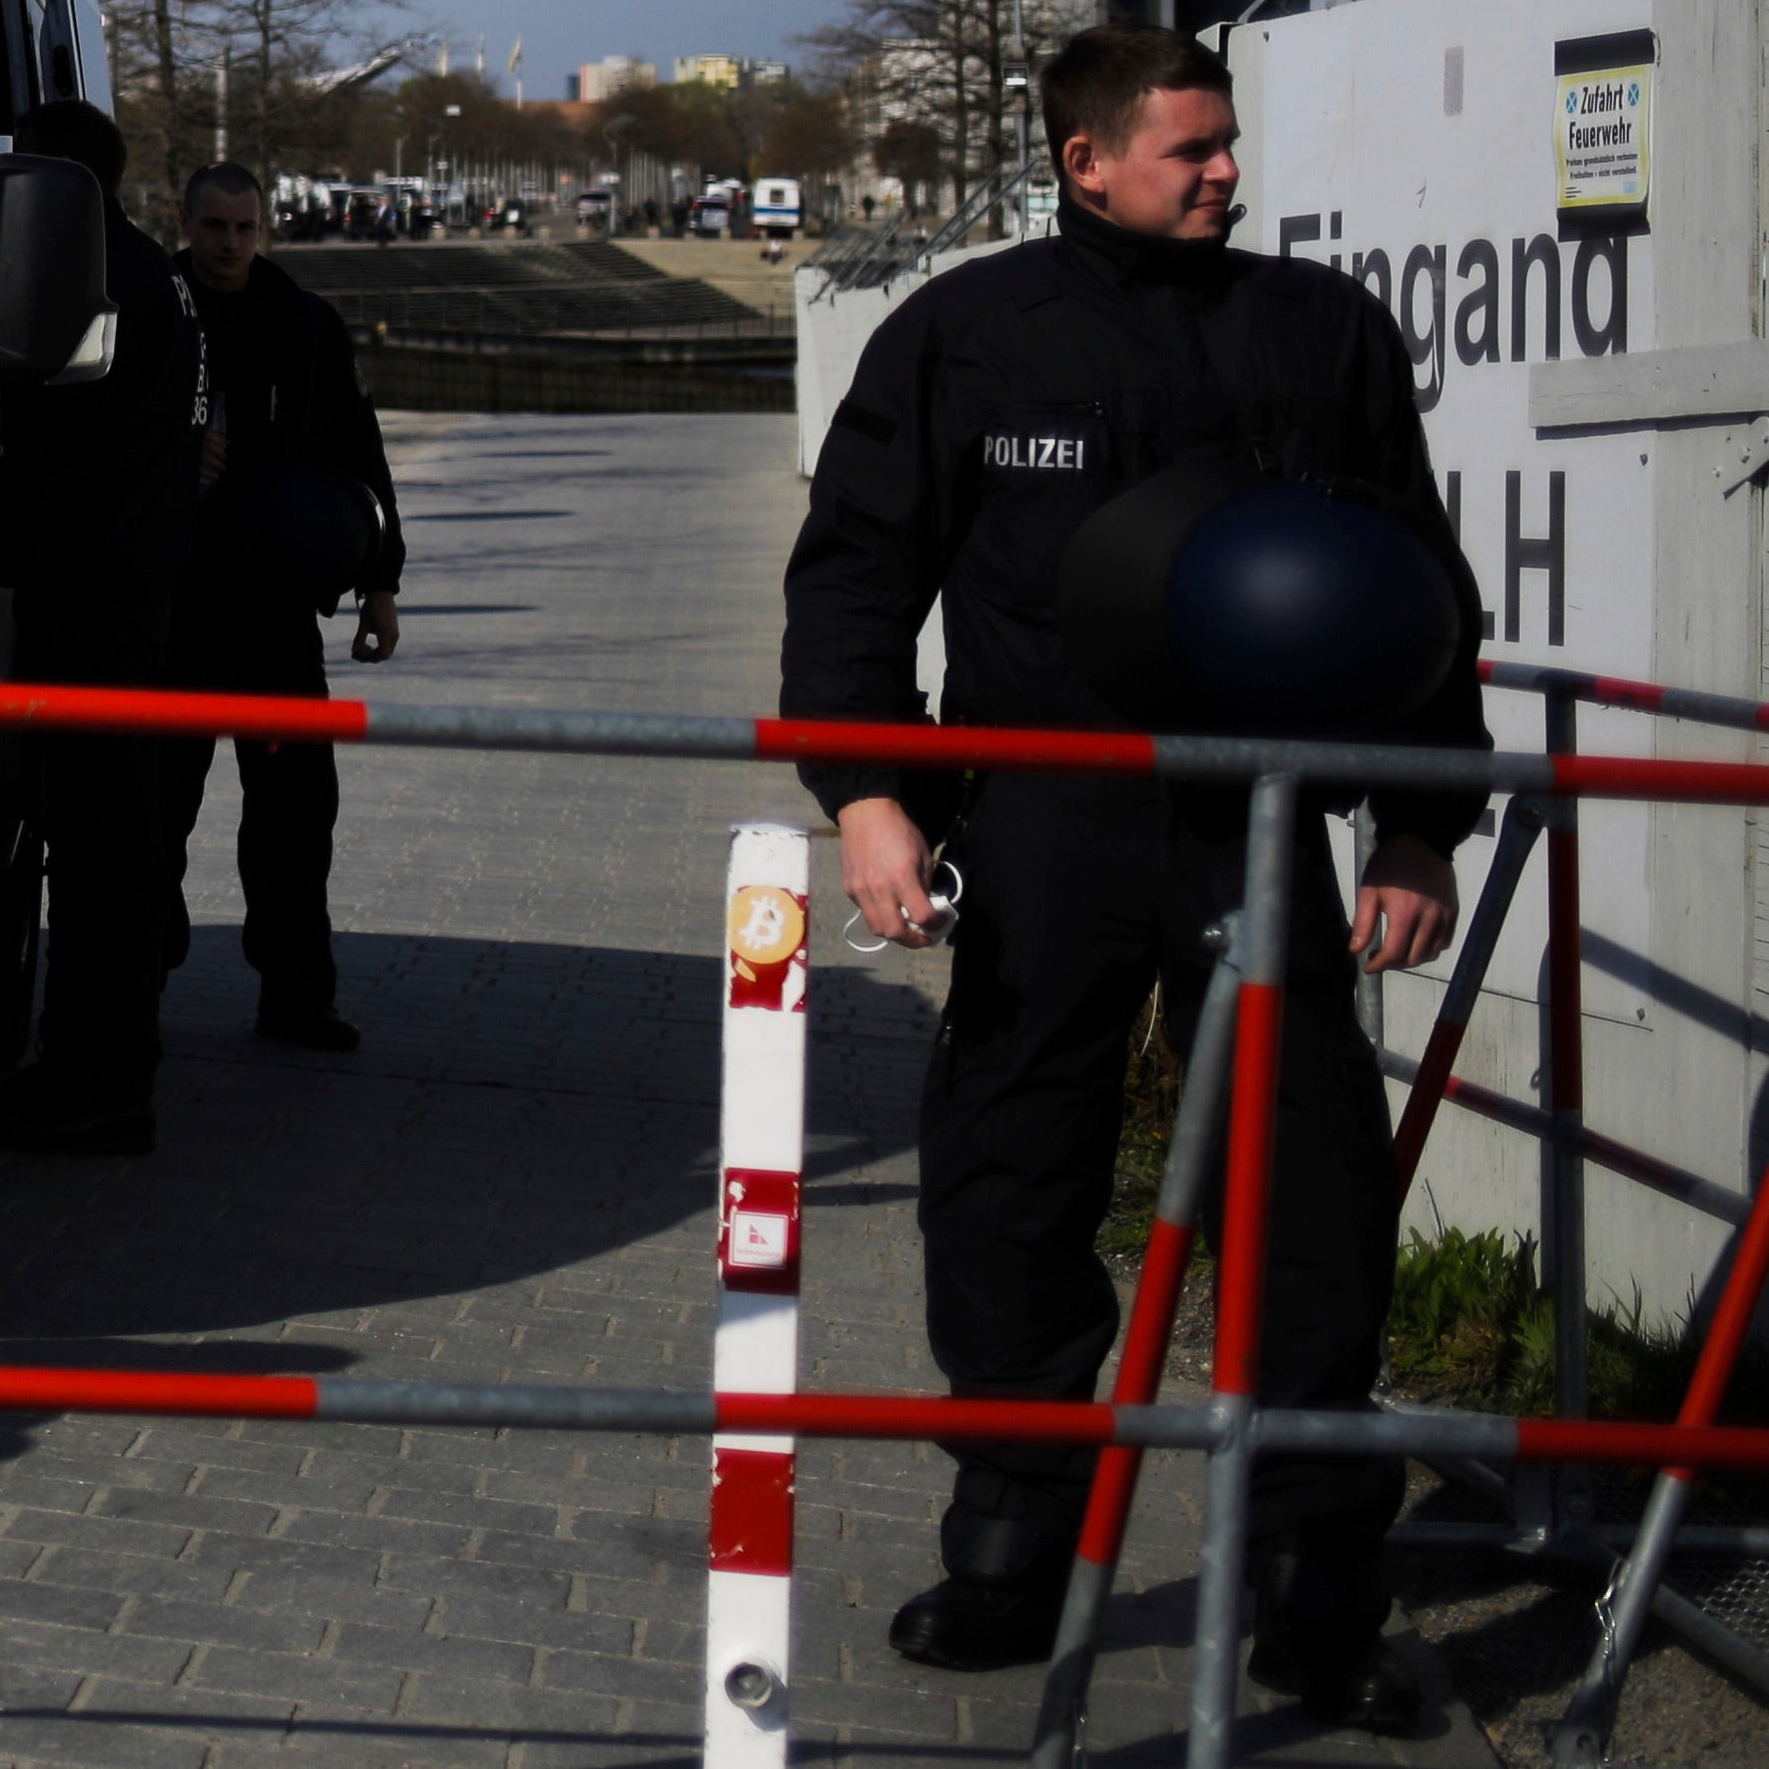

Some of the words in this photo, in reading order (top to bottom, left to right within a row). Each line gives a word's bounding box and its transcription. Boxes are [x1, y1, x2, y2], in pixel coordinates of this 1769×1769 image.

[1581, 84, 1624, 114] Zufahrt
[1569, 116, 1632, 150] Feuerwehr
[1280, 210, 1628, 413] ngand
[984, 436, 1084, 470] POLIZEI
